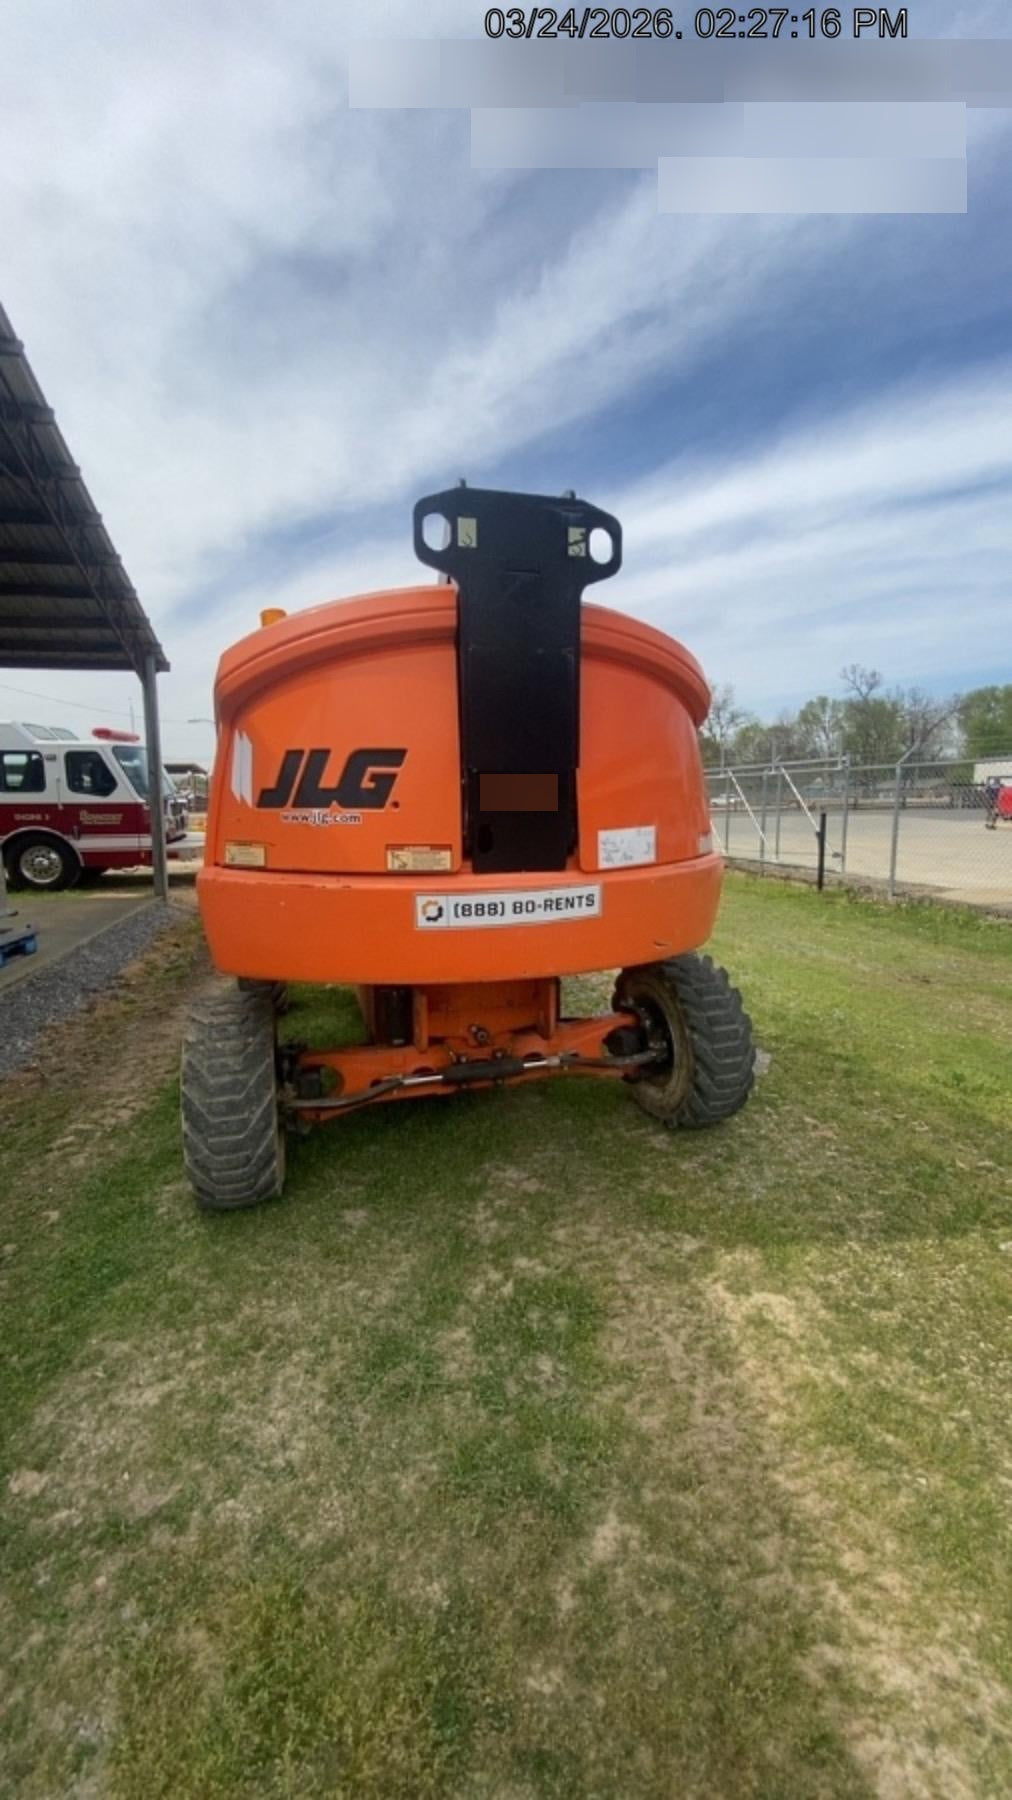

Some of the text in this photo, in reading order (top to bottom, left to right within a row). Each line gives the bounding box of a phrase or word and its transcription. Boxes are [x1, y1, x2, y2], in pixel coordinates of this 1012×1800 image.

[256, 748, 408, 809] JLG
[281, 810, 361, 825] www.jlg.com
[453, 902, 505, 919] (888)
